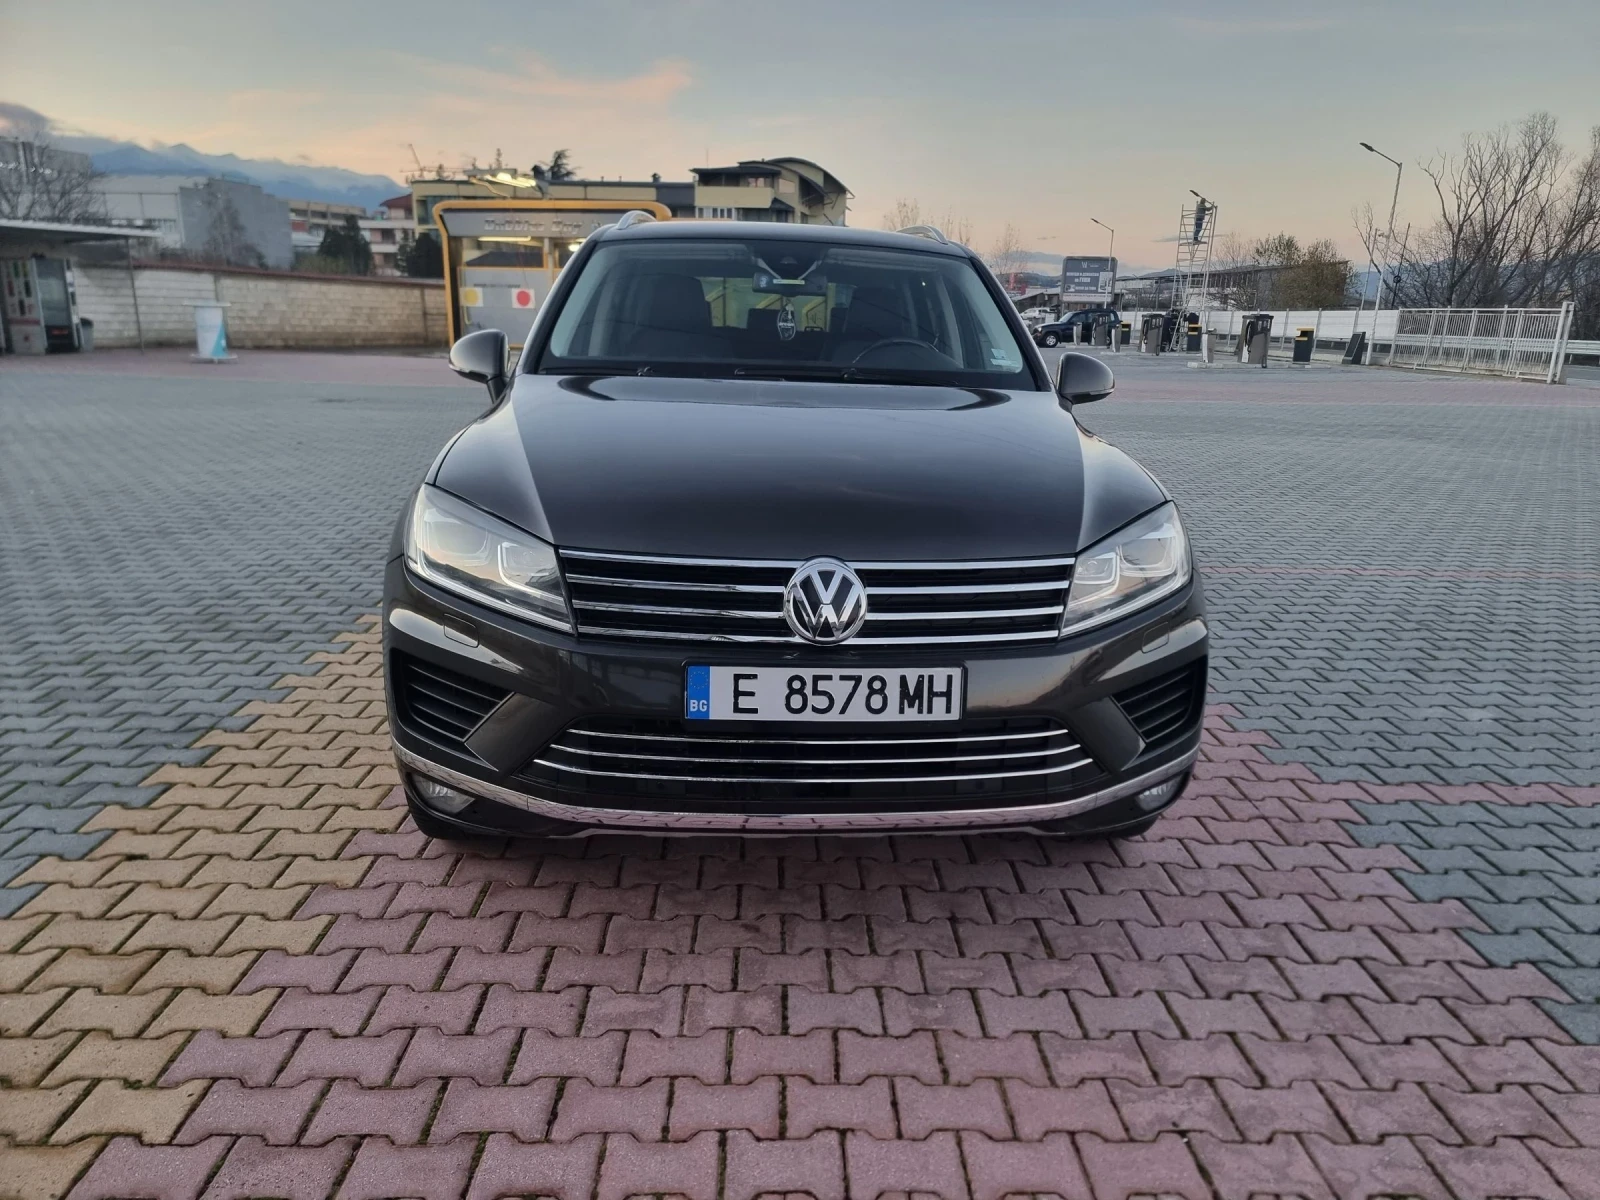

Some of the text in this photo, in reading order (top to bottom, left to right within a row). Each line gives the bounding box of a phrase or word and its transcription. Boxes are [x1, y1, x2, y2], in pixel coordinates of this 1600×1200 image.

[787, 561, 862, 640] VW
[689, 699, 708, 712] BG
[732, 673, 954, 715] E 8578 MH
